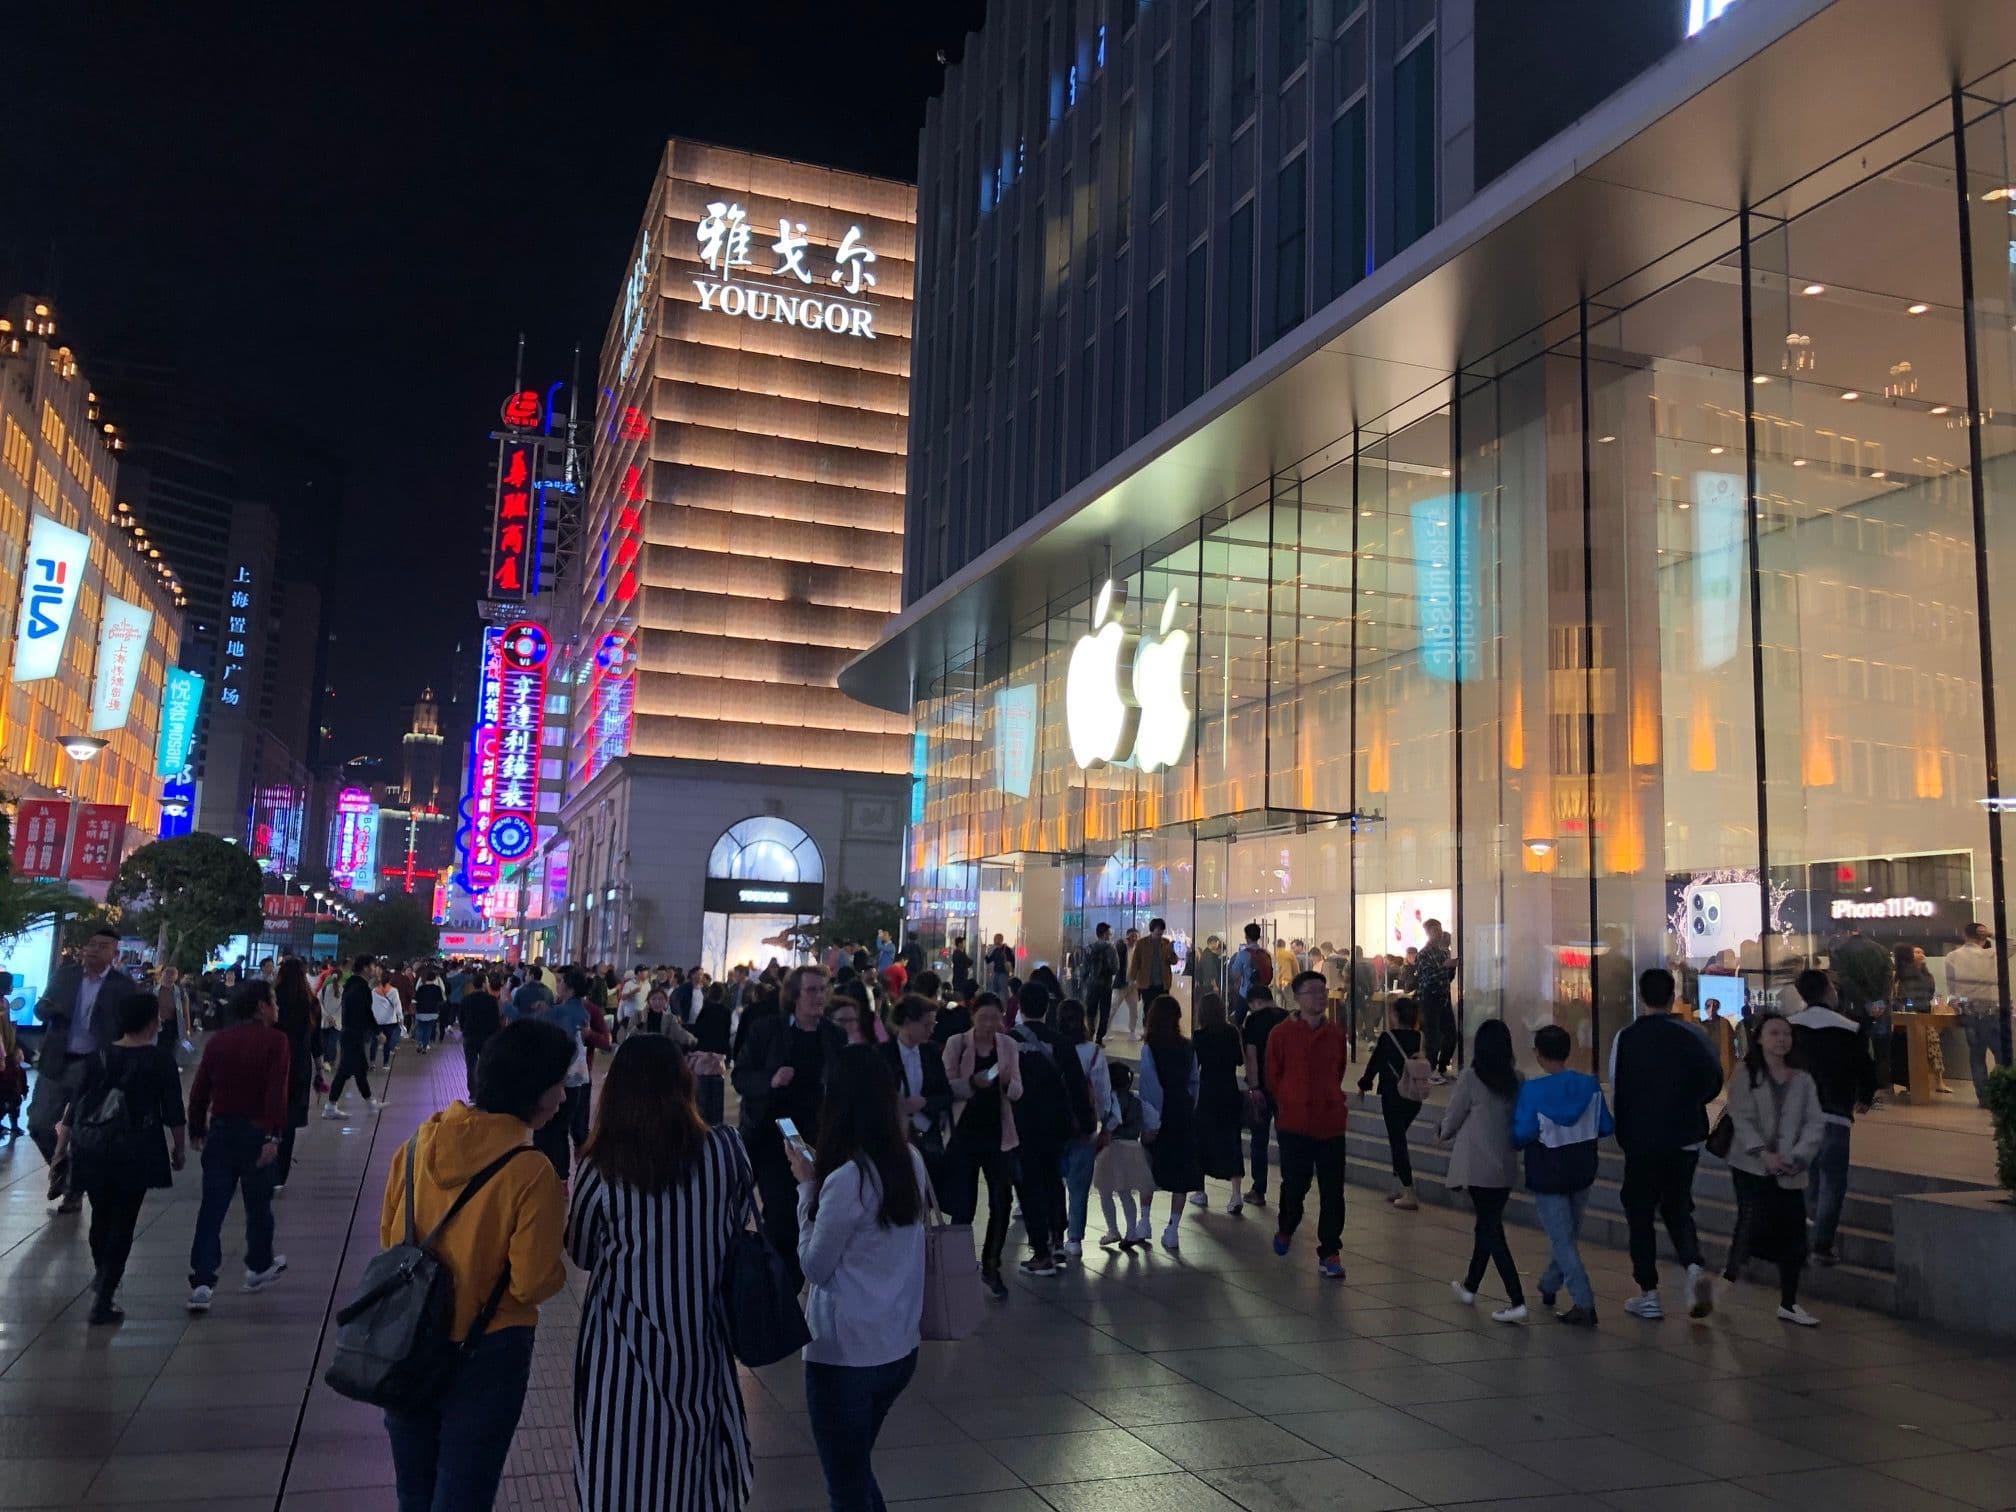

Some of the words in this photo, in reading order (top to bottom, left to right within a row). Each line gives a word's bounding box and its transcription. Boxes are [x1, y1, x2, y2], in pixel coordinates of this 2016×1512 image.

[697, 202, 876, 295] 雅戈尔
[693, 281, 876, 339] YOUNGOR
[27, 558, 67, 640] FILA
[221, 566, 251, 706] 上海置地广场
[1831, 899, 1886, 919] iPhone
[1885, 898, 1901, 918] 11
[1903, 897, 1935, 917] Pro
